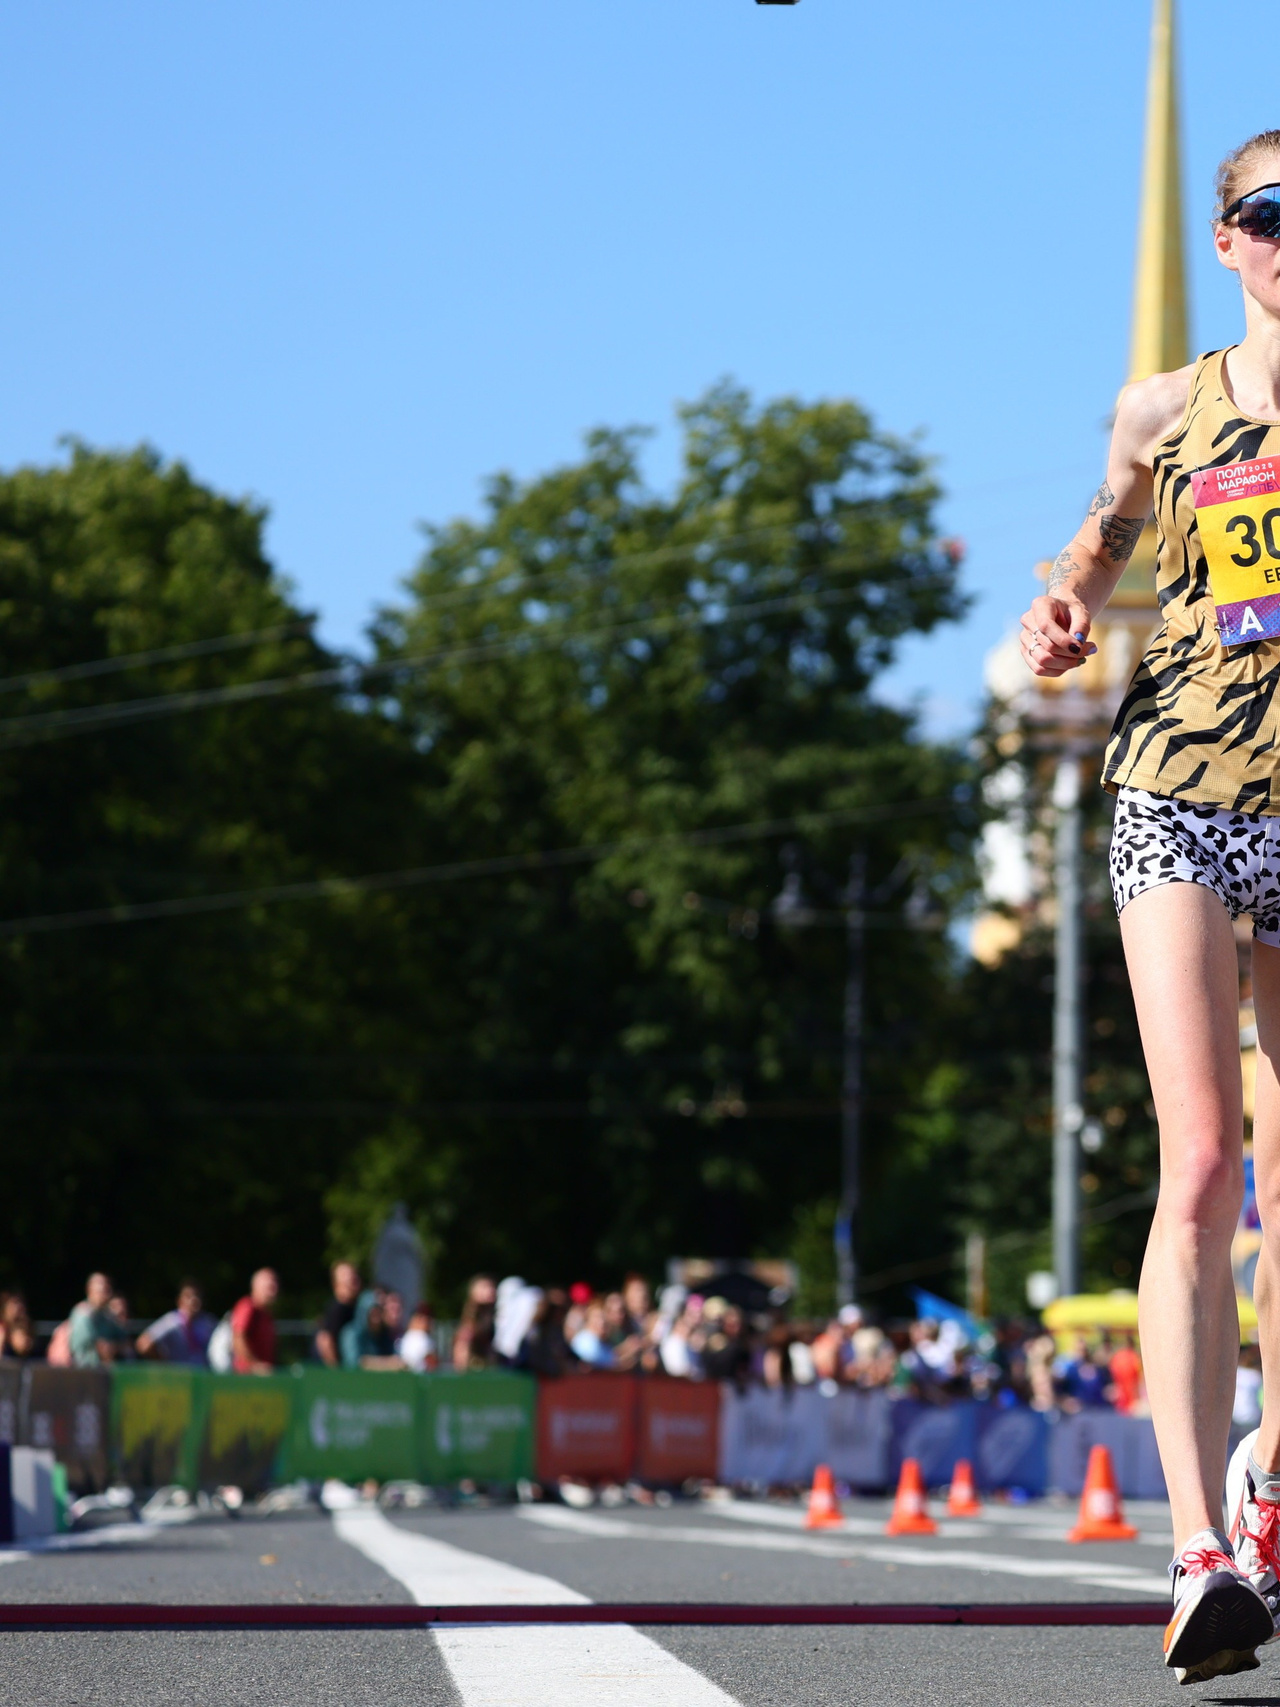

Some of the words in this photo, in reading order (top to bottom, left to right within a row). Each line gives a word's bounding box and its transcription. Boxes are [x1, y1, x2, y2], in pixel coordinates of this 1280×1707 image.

[1216, 465, 1247, 481] ПОЛУ
[1248, 462, 1273, 473] 2025
[1217, 470, 1276, 492] МАРАФОН
